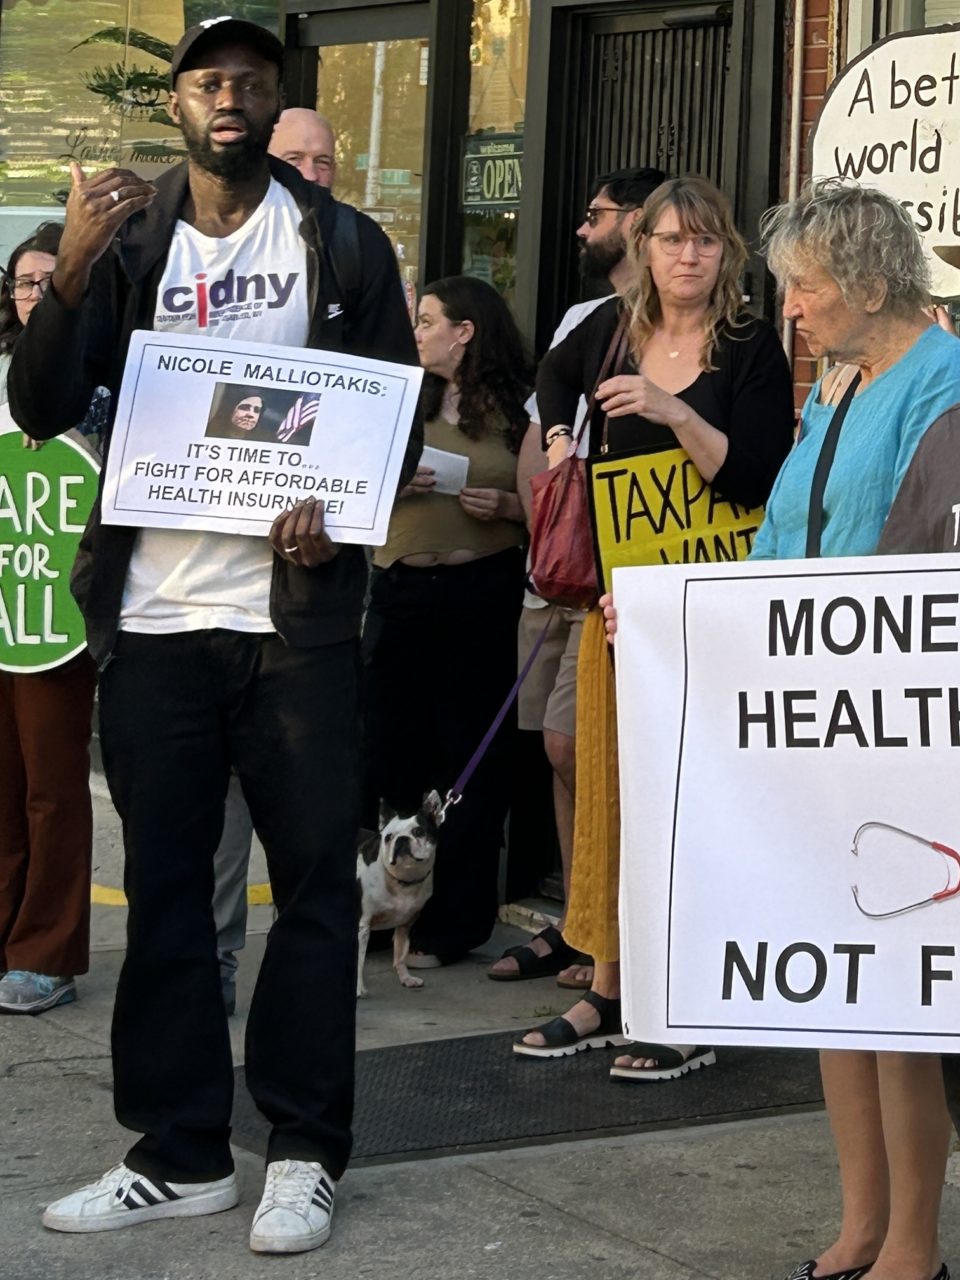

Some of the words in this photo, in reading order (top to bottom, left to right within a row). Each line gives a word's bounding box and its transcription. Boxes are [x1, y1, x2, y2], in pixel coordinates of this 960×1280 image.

[848, 68, 874, 117] A
[834, 118, 942, 181] world
[162, 269, 300, 328] cidny
[157, 354, 233, 376] NICOLE
[244, 363, 388, 397] MALLIOTAKIS:
[187, 443, 221, 461] IT'S
[227, 446, 270, 464] TIME
[135, 462, 190, 481] FIGHT
[195, 466, 233, 484] FOR
[238, 469, 369, 495] AFFORDABLE
[148, 486, 221, 506] HEALTH
[722, 940, 876, 1006] NOT
